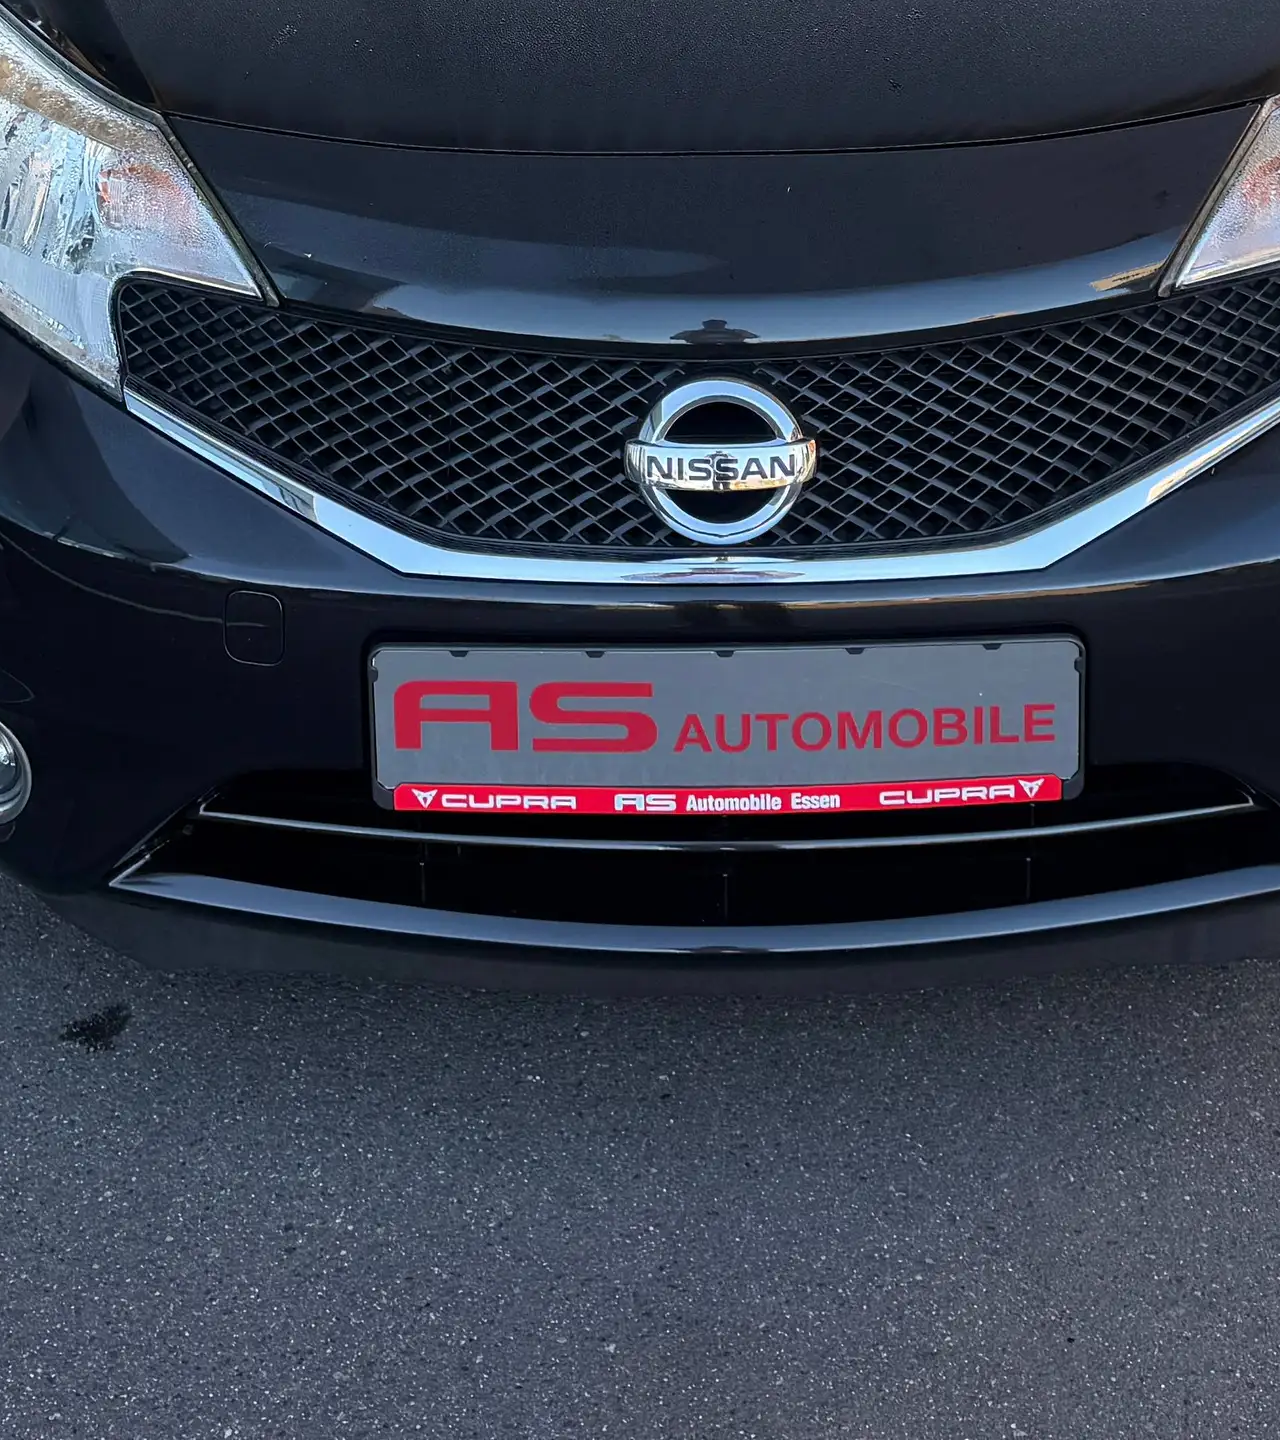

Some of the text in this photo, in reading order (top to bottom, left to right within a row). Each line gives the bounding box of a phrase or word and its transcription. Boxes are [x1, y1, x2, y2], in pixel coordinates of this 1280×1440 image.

[646, 454, 797, 482] NISSAN
[393, 679, 1057, 754] AS AUTOMOBILE
[441, 783, 1016, 812] CUPRA AS Automobile Essen CUPRA
